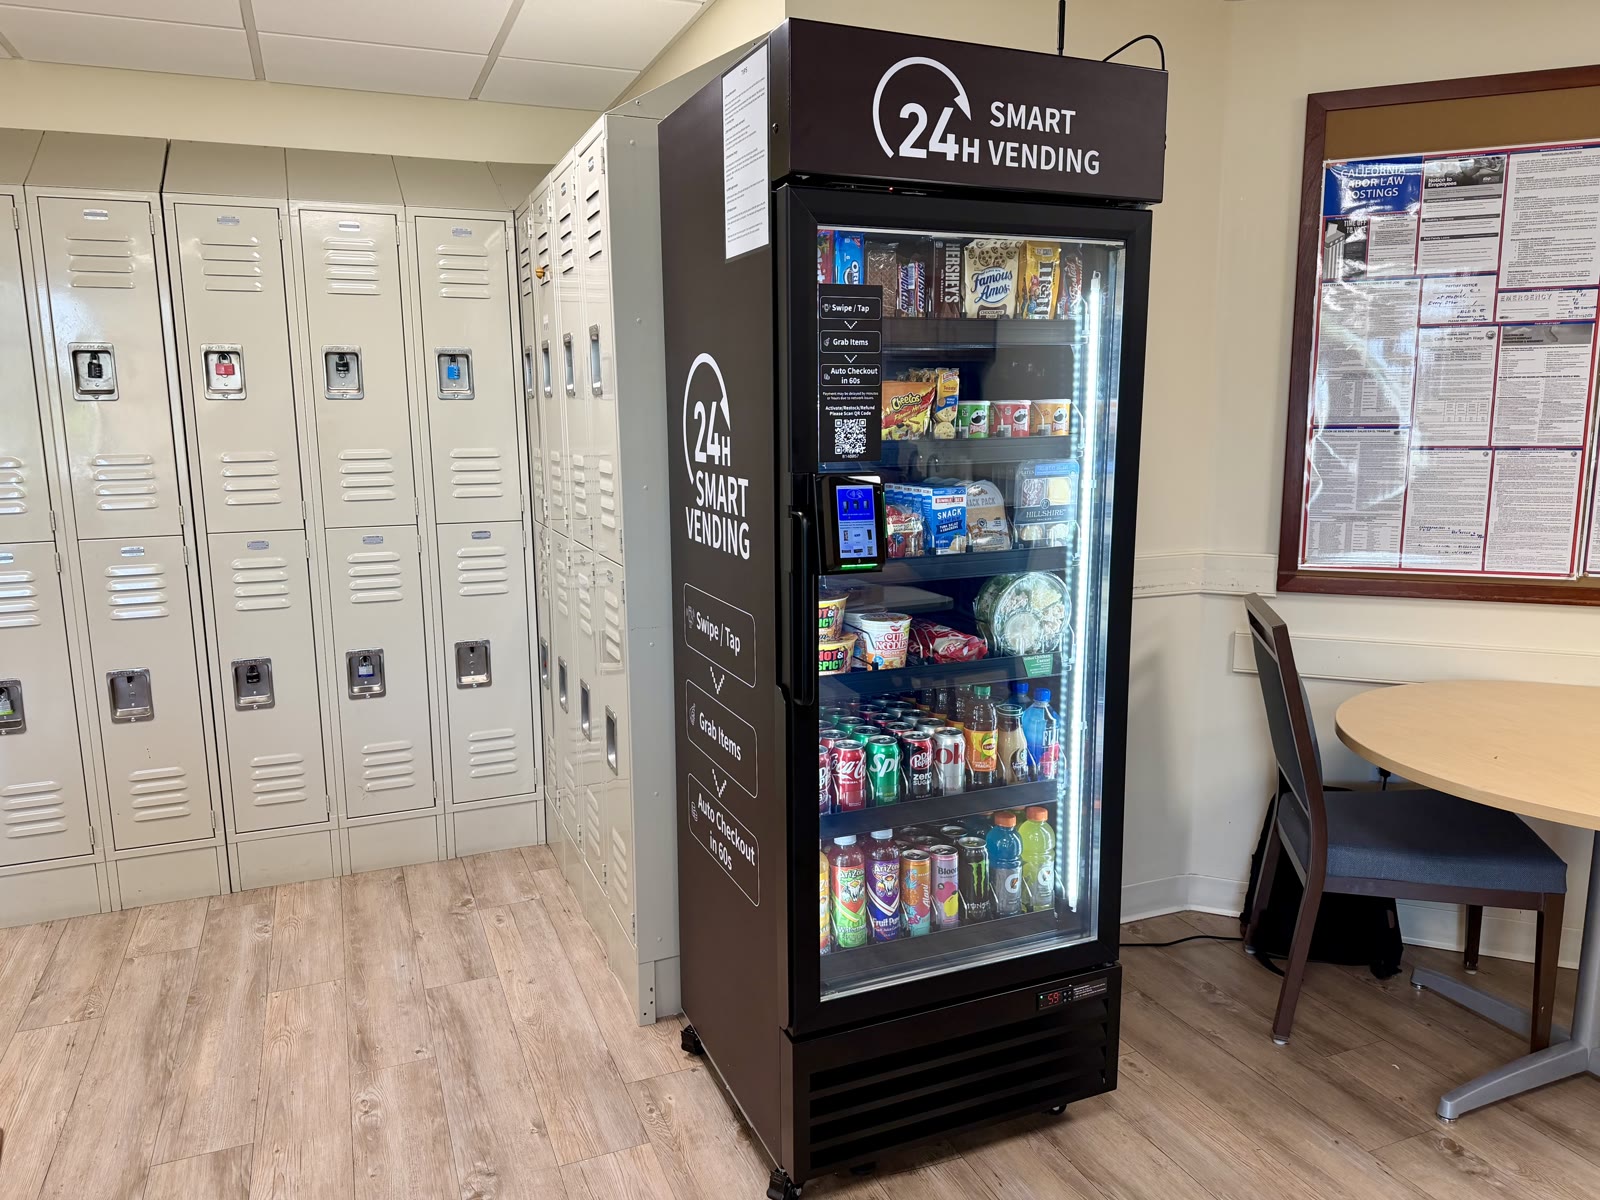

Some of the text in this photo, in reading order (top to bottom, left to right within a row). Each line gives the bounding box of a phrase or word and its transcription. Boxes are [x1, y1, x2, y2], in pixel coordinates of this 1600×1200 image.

[989, 101, 1076, 135] SMART
[898, 101, 980, 164] 24H
[988, 139, 1101, 175] VENDING
[1341, 166, 1406, 178] CALIFORNIA
[1341, 176, 1405, 188] LABOR LAW
[1350, 188, 1399, 199] OSTINGS
[851, 261, 859, 285] OR
[945, 243, 961, 303] HERSHEY'S
[971, 269, 1013, 293] Famous
[974, 285, 1010, 303] Amos
[1500, 293, 1552, 302] EMERGENCY
[831, 303, 852, 313] Swipe
[857, 304, 870, 313] Tap
[832, 338, 869, 346] Grab Items
[830, 367, 879, 375] Auto Checkout
[841, 376, 848, 384] in
[890, 393, 922, 412] Cheetos
[694, 400, 731, 467] 24H
[695, 470, 749, 518] SMART
[981, 497, 997, 506] PACK
[936, 508, 962, 520] SNACK
[1025, 509, 1065, 519] HILLSHIRE
[685, 506, 750, 560] VENDING
[696, 611, 719, 642] Swipe
[725, 627, 741, 657] Tap
[884, 632, 905, 642] CUP
[699, 712, 742, 761] Grab Items
[698, 793, 756, 866] Auto Checkout
[709, 830, 733, 871] in 60s
[872, 917, 889, 927] Fruit
